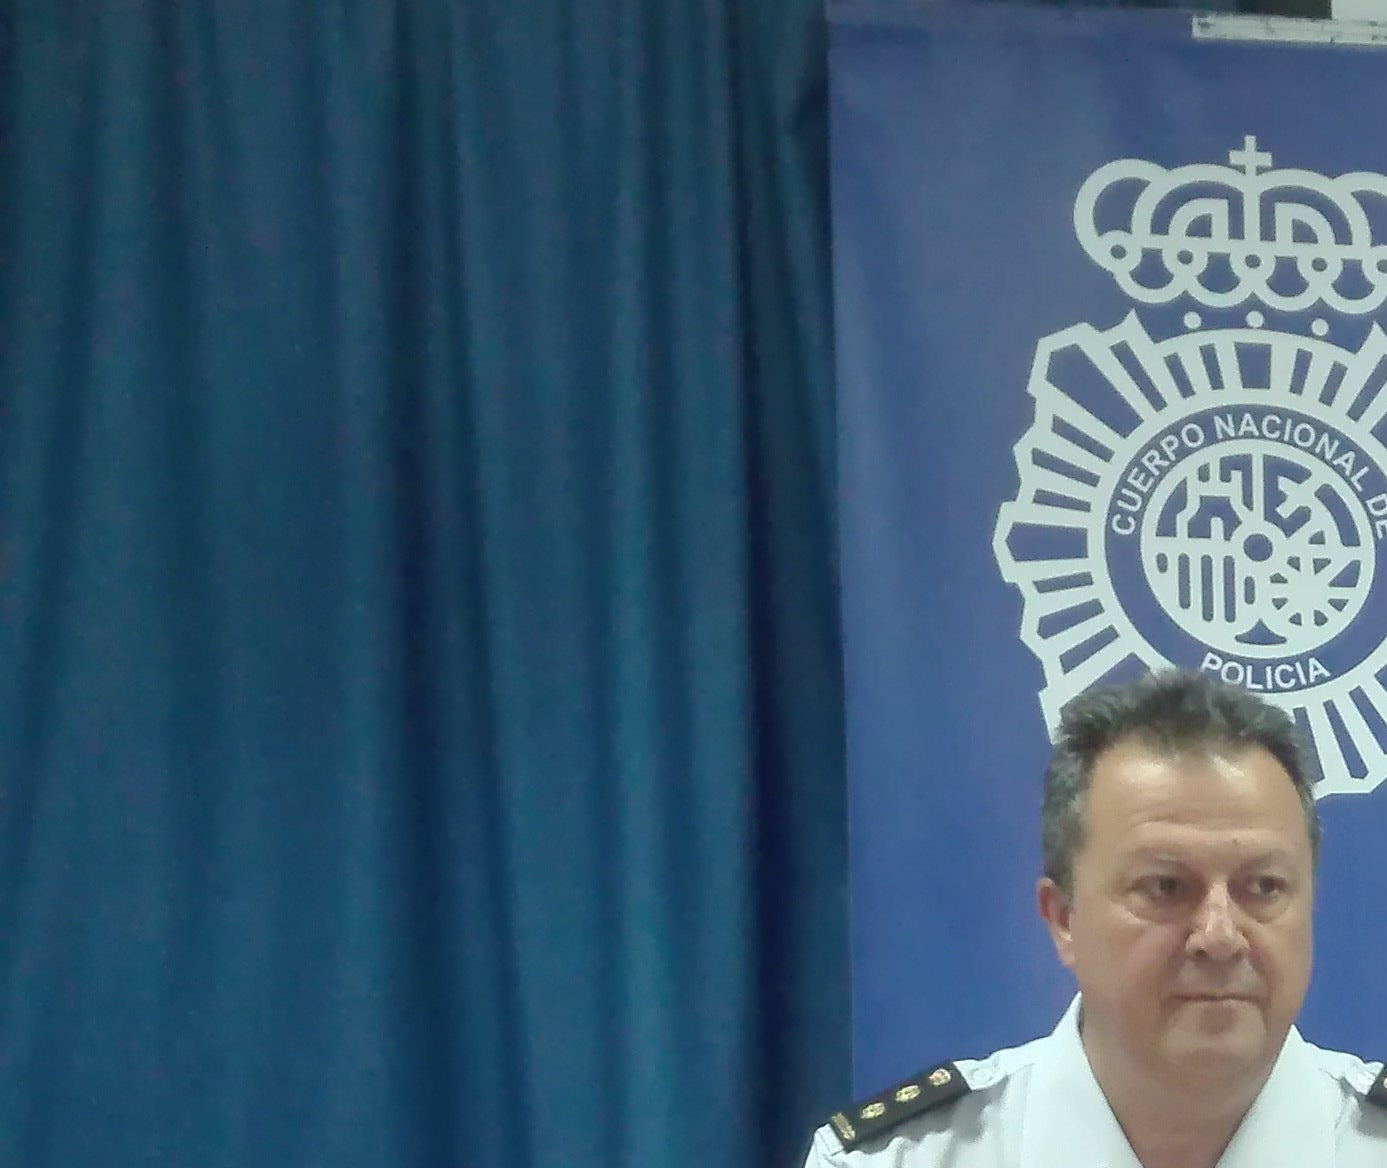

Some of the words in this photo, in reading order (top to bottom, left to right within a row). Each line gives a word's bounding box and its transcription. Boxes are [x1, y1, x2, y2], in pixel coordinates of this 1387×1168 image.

[1111, 423, 1204, 535] CUERPO
[1213, 412, 1370, 492] NACIONAL
[1200, 651, 1331, 689] POLICIA
